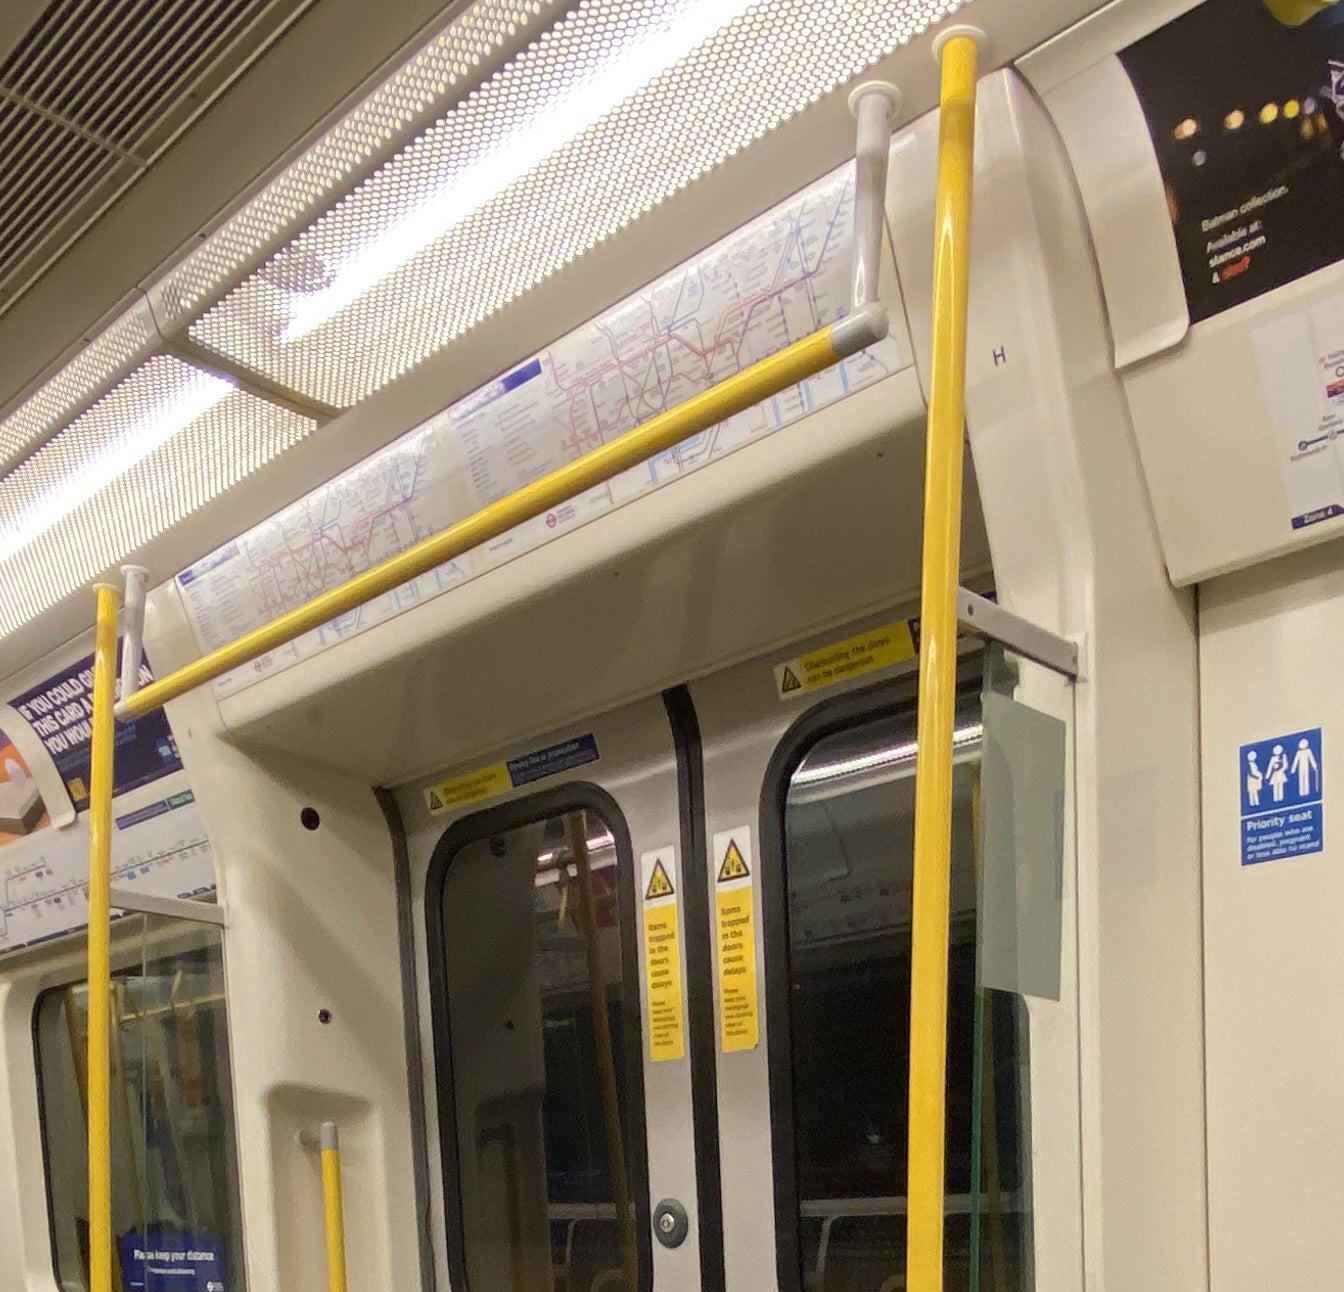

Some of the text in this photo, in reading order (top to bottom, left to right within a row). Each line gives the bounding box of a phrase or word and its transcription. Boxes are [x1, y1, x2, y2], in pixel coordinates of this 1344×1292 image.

[1209, 235, 1266, 268] stance.com
[993, 345, 1006, 367] H
[1304, 506, 1334, 524] Zone 4
[18, 704, 34, 721] IF
[26, 694, 53, 715] YOU
[46, 678, 85, 705] COULD
[33, 714, 60, 737] THIS
[54, 702, 85, 726] CARD
[44, 732, 69, 755] YOU
[1246, 810, 1313, 832] Priority seat
